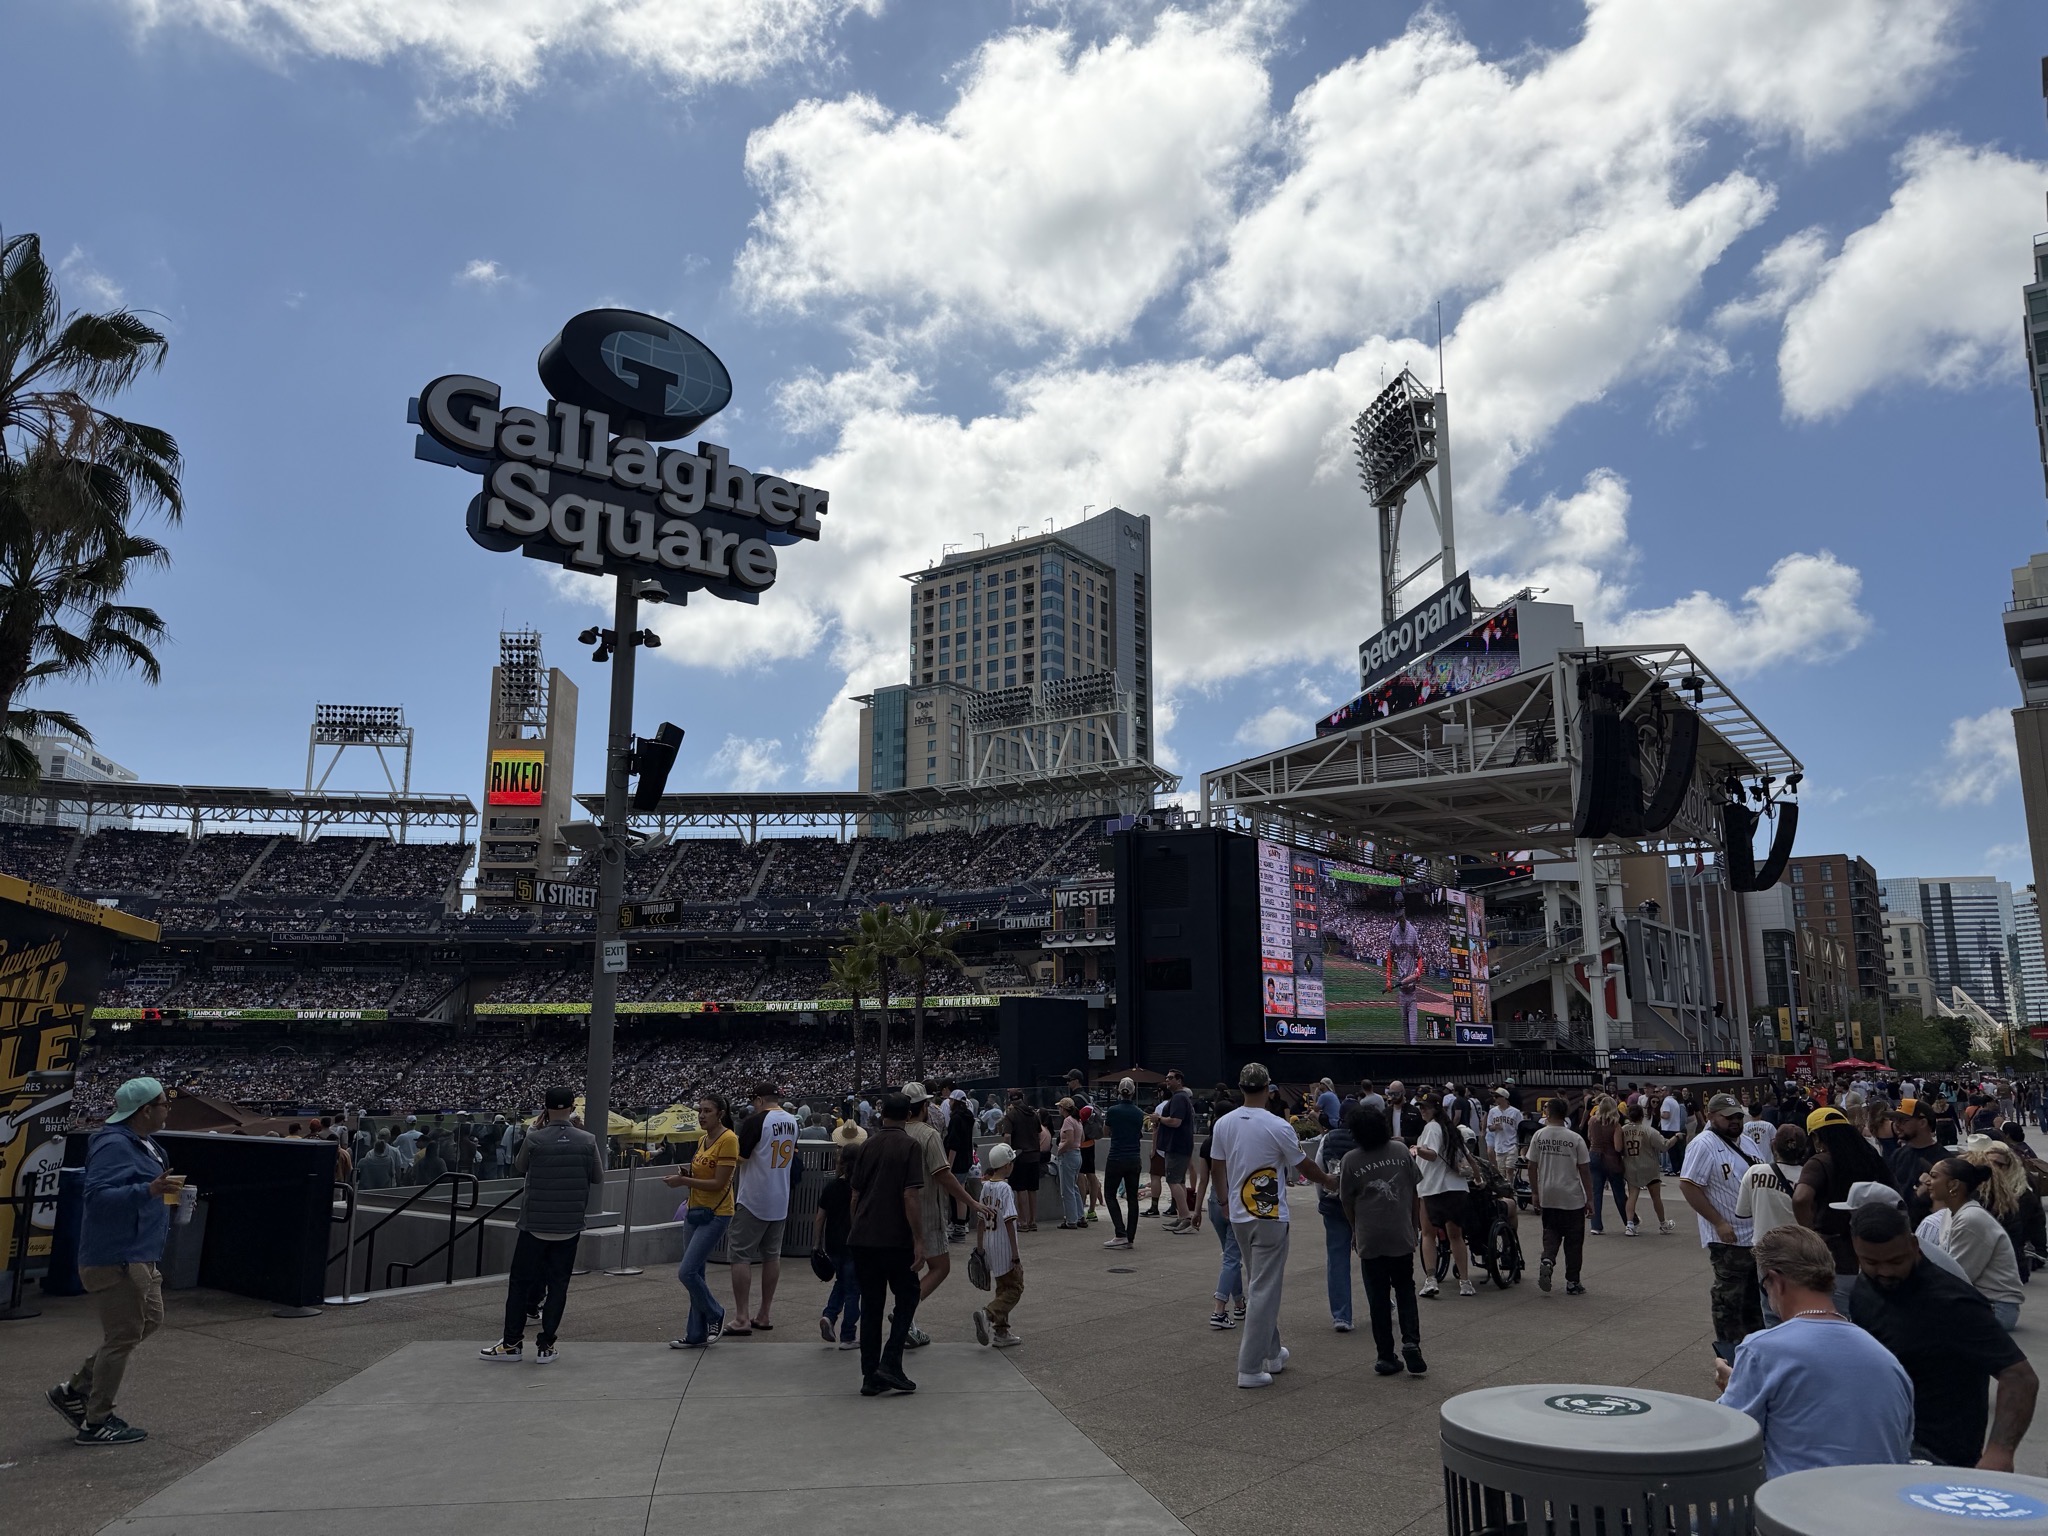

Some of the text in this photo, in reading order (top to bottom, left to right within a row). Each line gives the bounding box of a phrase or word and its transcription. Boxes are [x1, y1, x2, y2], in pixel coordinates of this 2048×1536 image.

[427, 375, 829, 532] Gallagher
[487, 461, 777, 586] Square
[1360, 583, 1467, 687] petco park
[492, 761, 542, 793] RIKEO
[35, 885, 60, 900] OFFICIAL
[61, 892, 77, 906] CRAFT
[536, 881, 547, 903] K
[549, 883, 598, 908] STREET
[35, 897, 96, 924] THE SAN DIEGO PADRES
[659, 902, 675, 913] BEACH
[1004, 917, 1051, 929] CUTWATER
[301, 934, 317, 943] Diego
[605, 946, 626, 957] EXIT
[211, 965, 246, 973] CUTWATER
[340, 1011, 362, 1019] DOWN
[1289, 1023, 1317, 1037] Gallagher
[1470, 1031, 1488, 1041] Gallagher
[772, 1122, 795, 1136] GWYNN
[1552, 1140, 1574, 1148] DIEGO
[1754, 1133, 1760, 1144] 2
[771, 1140, 793, 1168] 19
[1626, 1141, 1640, 1157] 23
[1353, 1159, 1405, 1178] KAVAHOLIC
